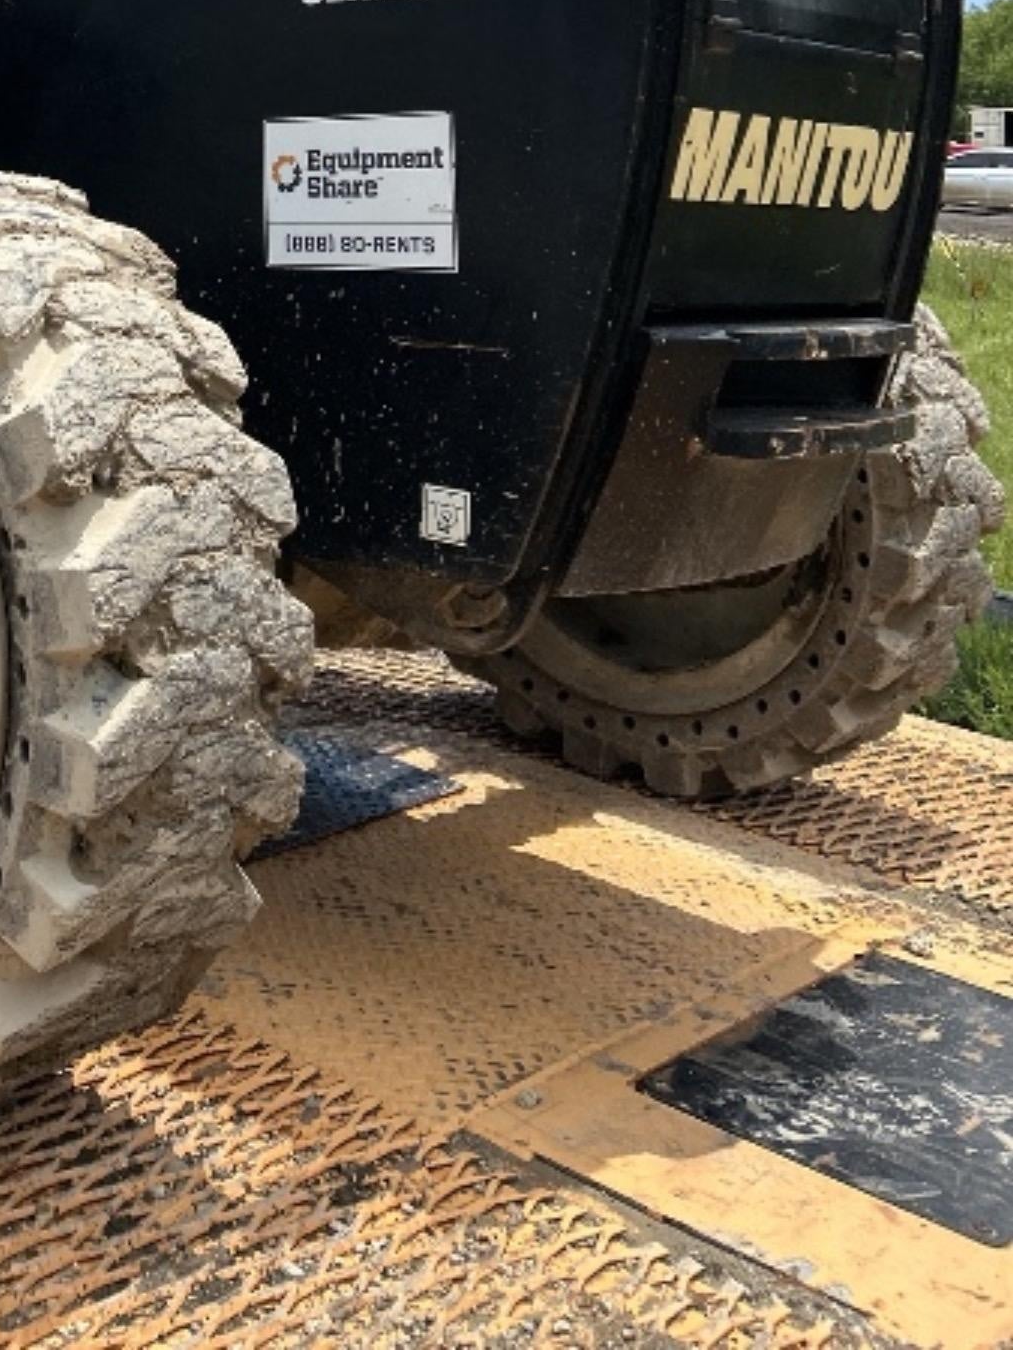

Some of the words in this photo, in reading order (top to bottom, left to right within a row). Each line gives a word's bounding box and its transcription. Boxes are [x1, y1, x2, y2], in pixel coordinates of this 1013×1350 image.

[307, 146, 444, 175] Equipment
[670, 107, 915, 212] MANITOU
[307, 176, 379, 199] Share
[286, 233, 334, 254] (888)
